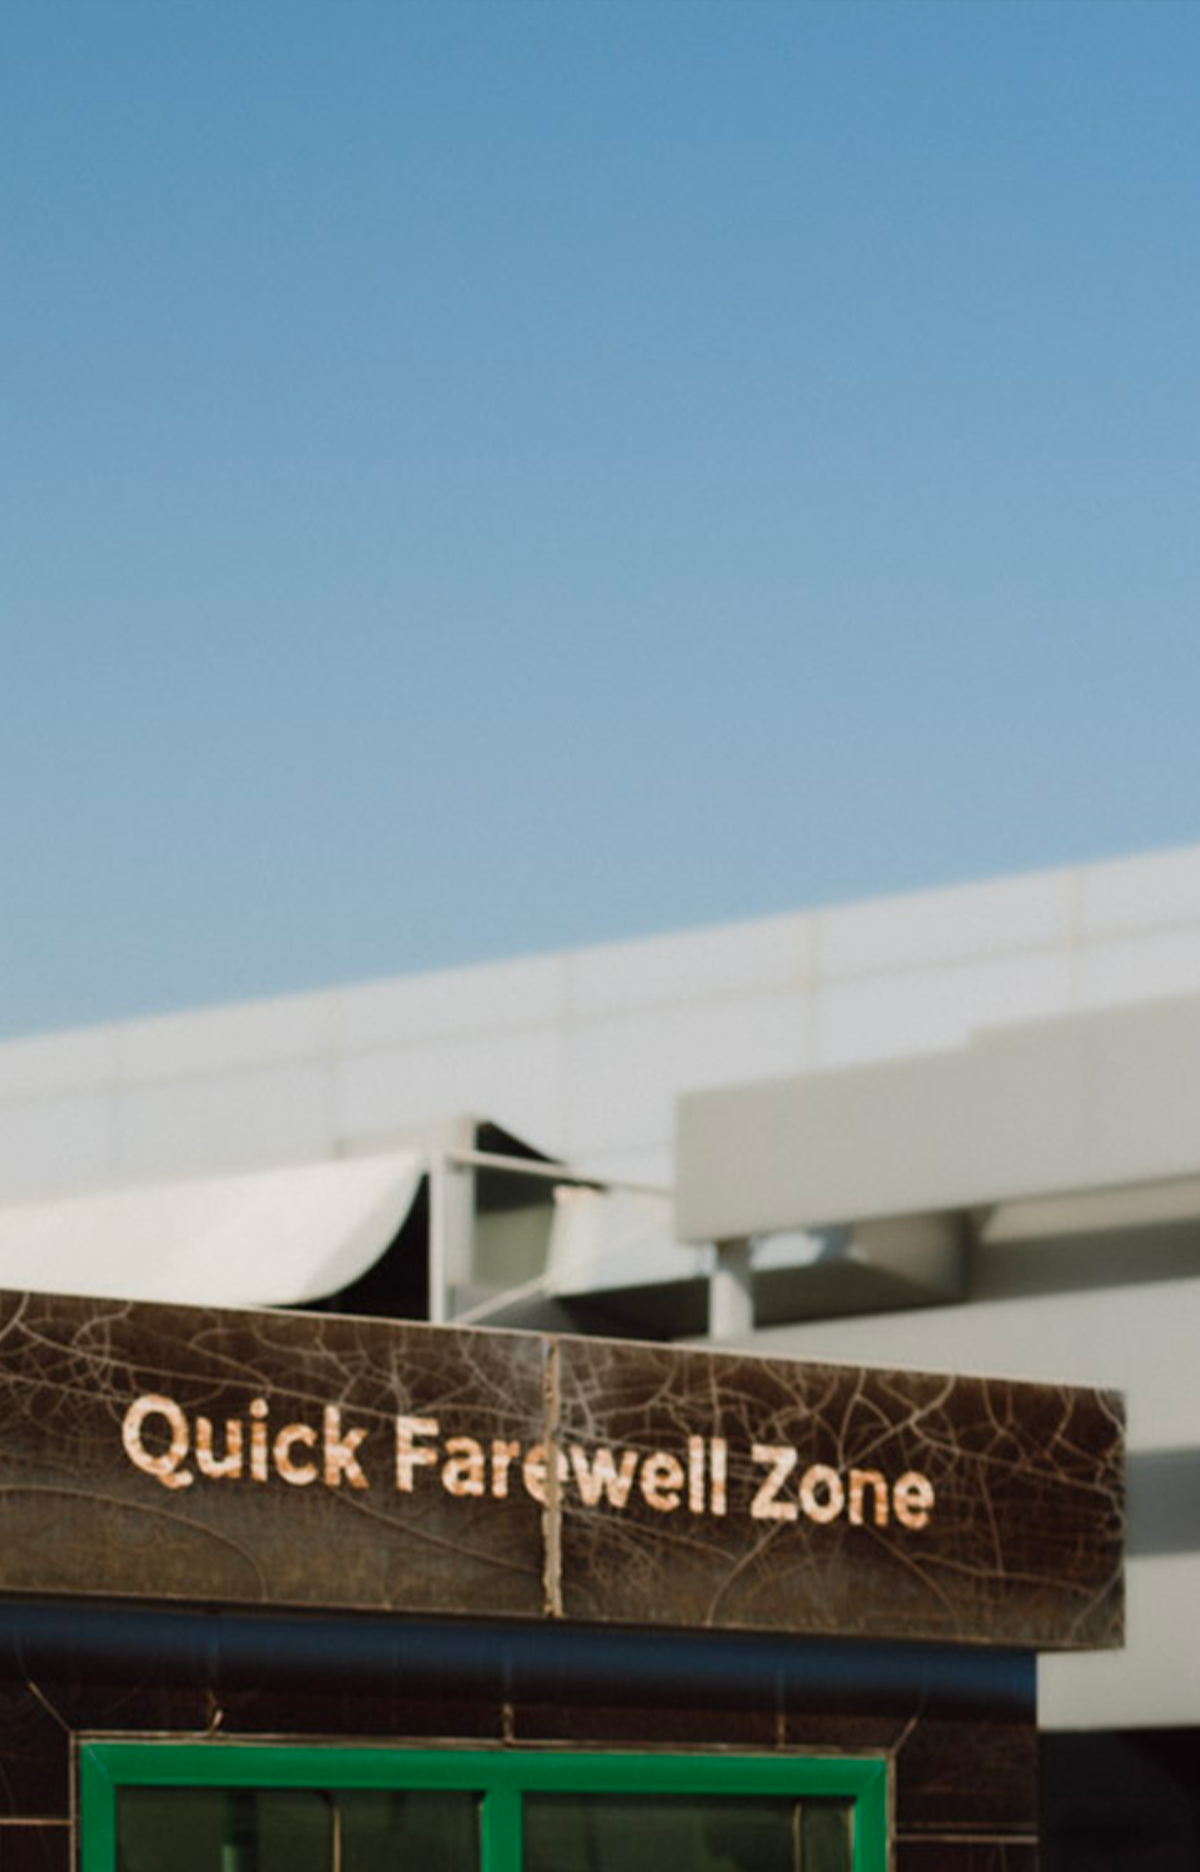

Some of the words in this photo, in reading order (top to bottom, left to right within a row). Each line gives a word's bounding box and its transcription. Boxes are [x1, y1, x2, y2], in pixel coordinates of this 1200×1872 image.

[122, 1393, 369, 1490] Quick
[395, 1415, 727, 1516] Farewell
[750, 1443, 935, 1530] Zone
